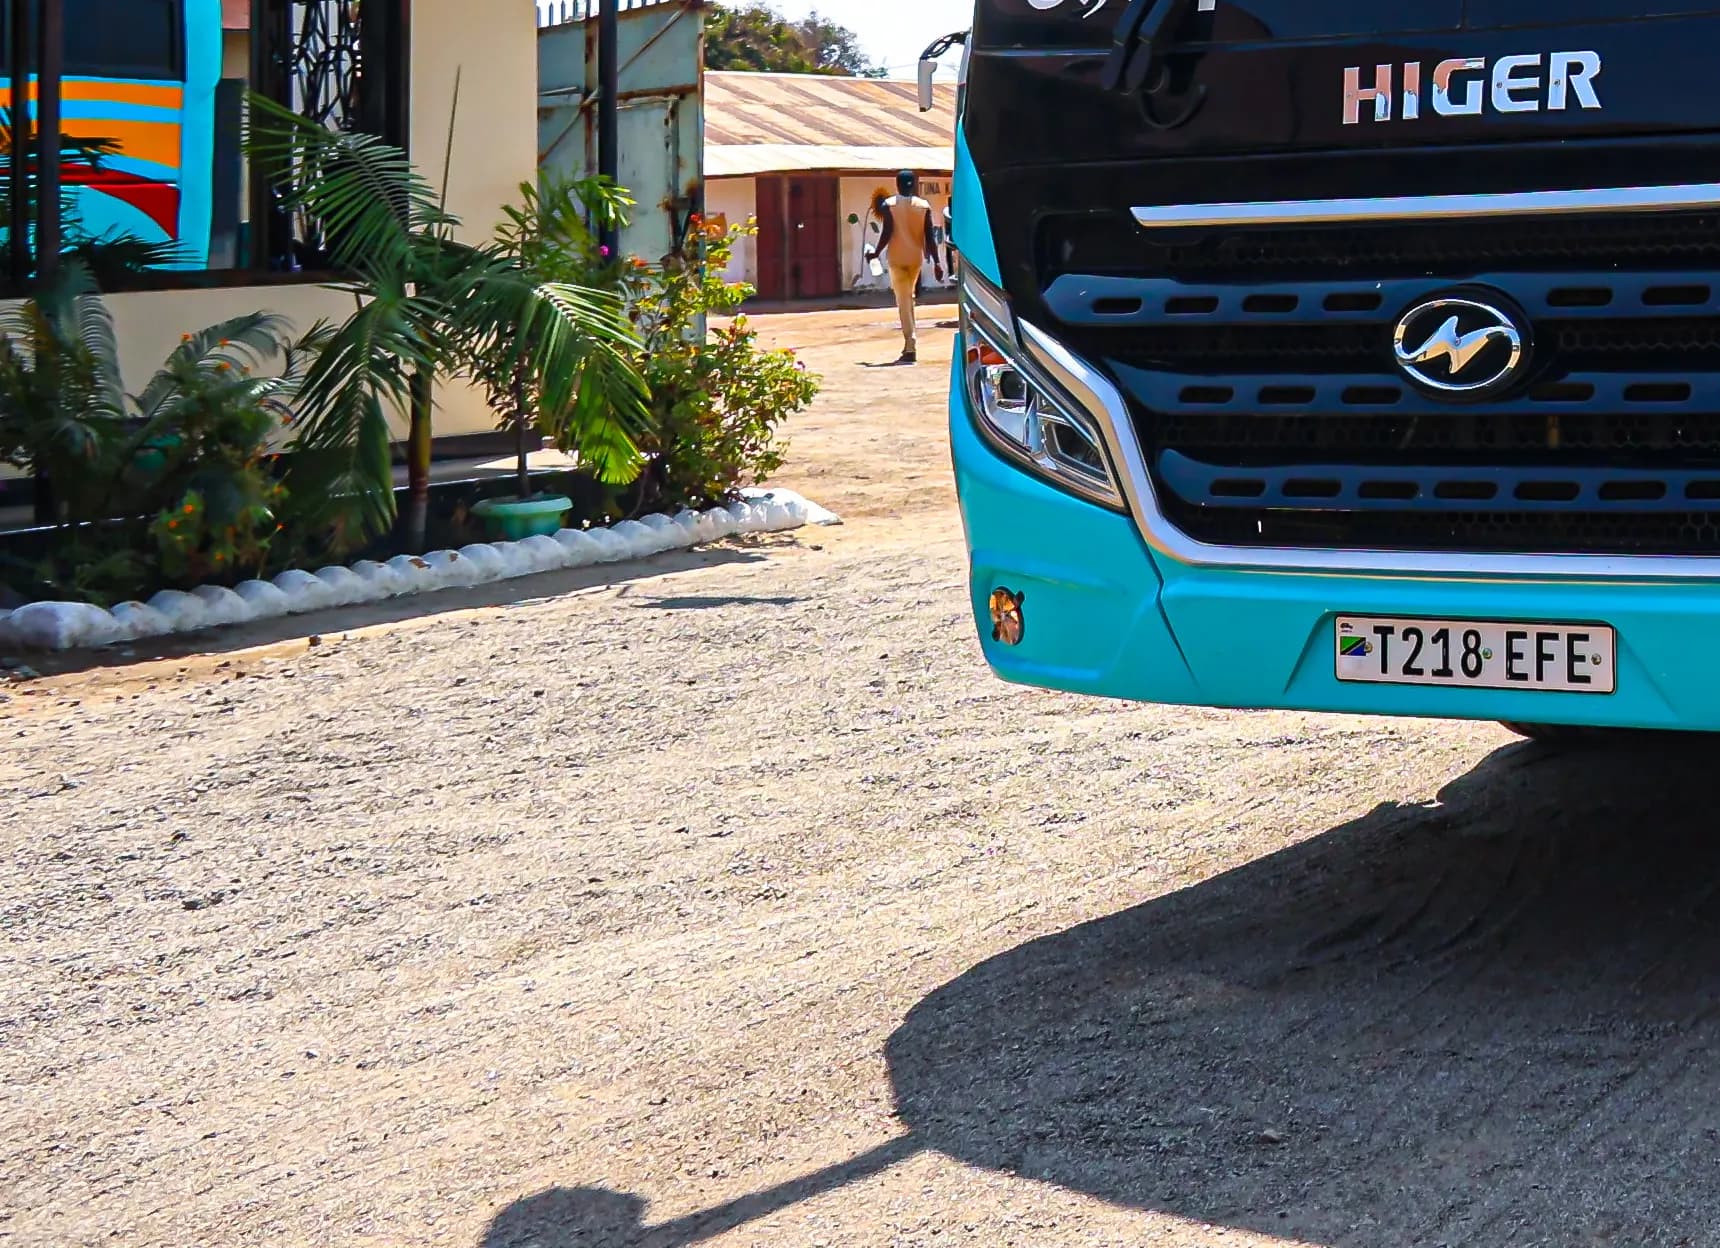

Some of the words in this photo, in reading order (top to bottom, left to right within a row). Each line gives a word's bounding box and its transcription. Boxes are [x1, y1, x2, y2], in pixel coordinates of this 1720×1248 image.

[1342, 50, 1602, 125] HIGER
[1373, 624, 1483, 679] T218
[1505, 630, 1593, 685] EFE
